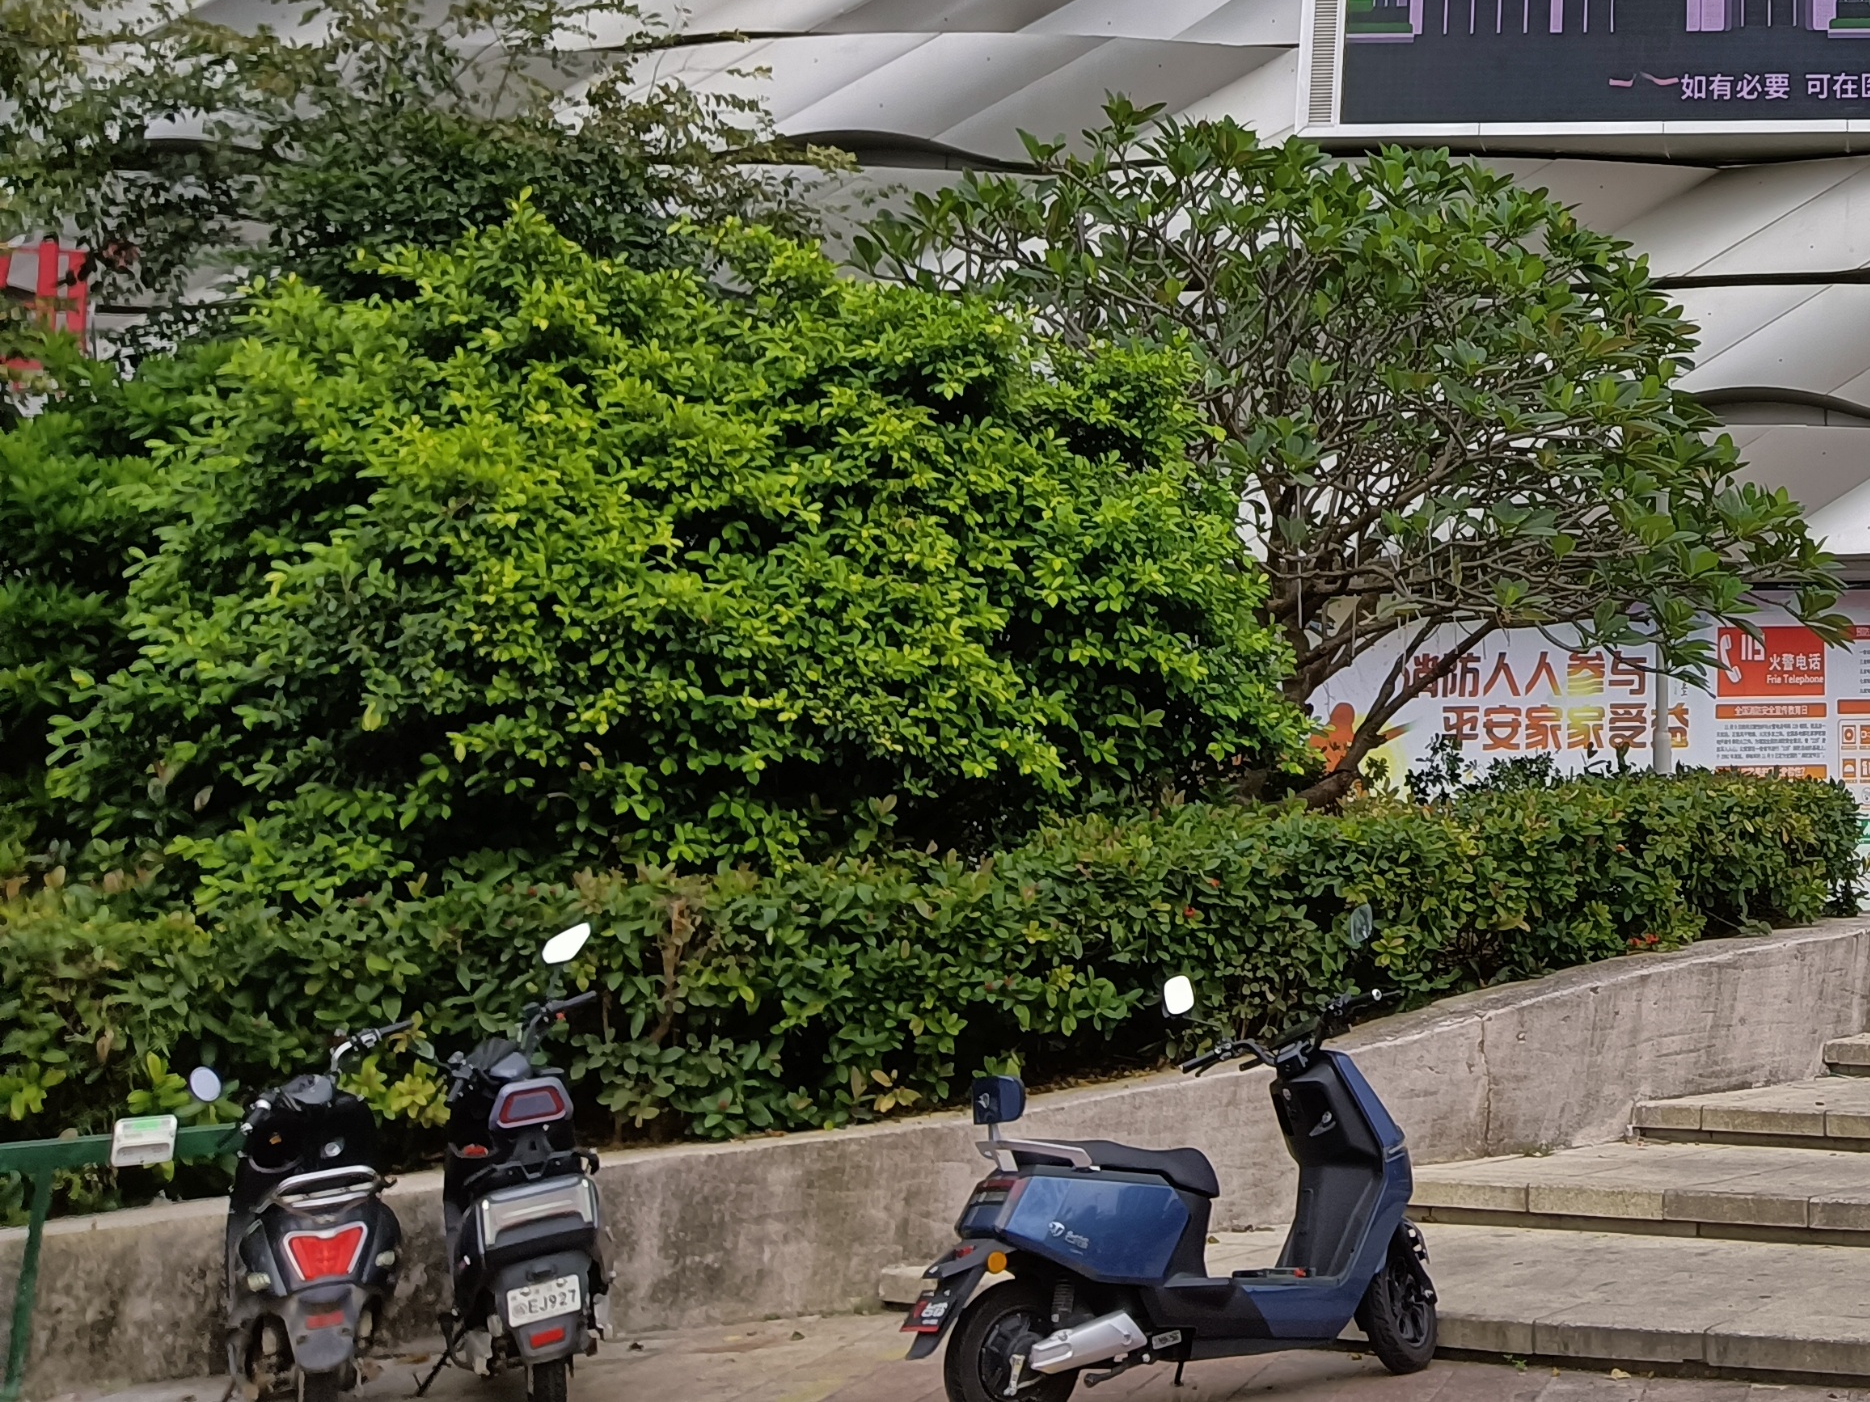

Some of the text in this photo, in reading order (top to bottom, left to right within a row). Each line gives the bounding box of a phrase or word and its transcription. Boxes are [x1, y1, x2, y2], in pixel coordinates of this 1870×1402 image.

[1680, 73, 1790, 100] 如有必要
[1403, 651, 1648, 699] 消防人人参与
[1768, 653, 1822, 671] 火警电话
[1783, 674, 1824, 685] Telephone
[1442, 702, 1690, 751] 平安家家受益
[527, 1288, 577, 1314] EJ927
